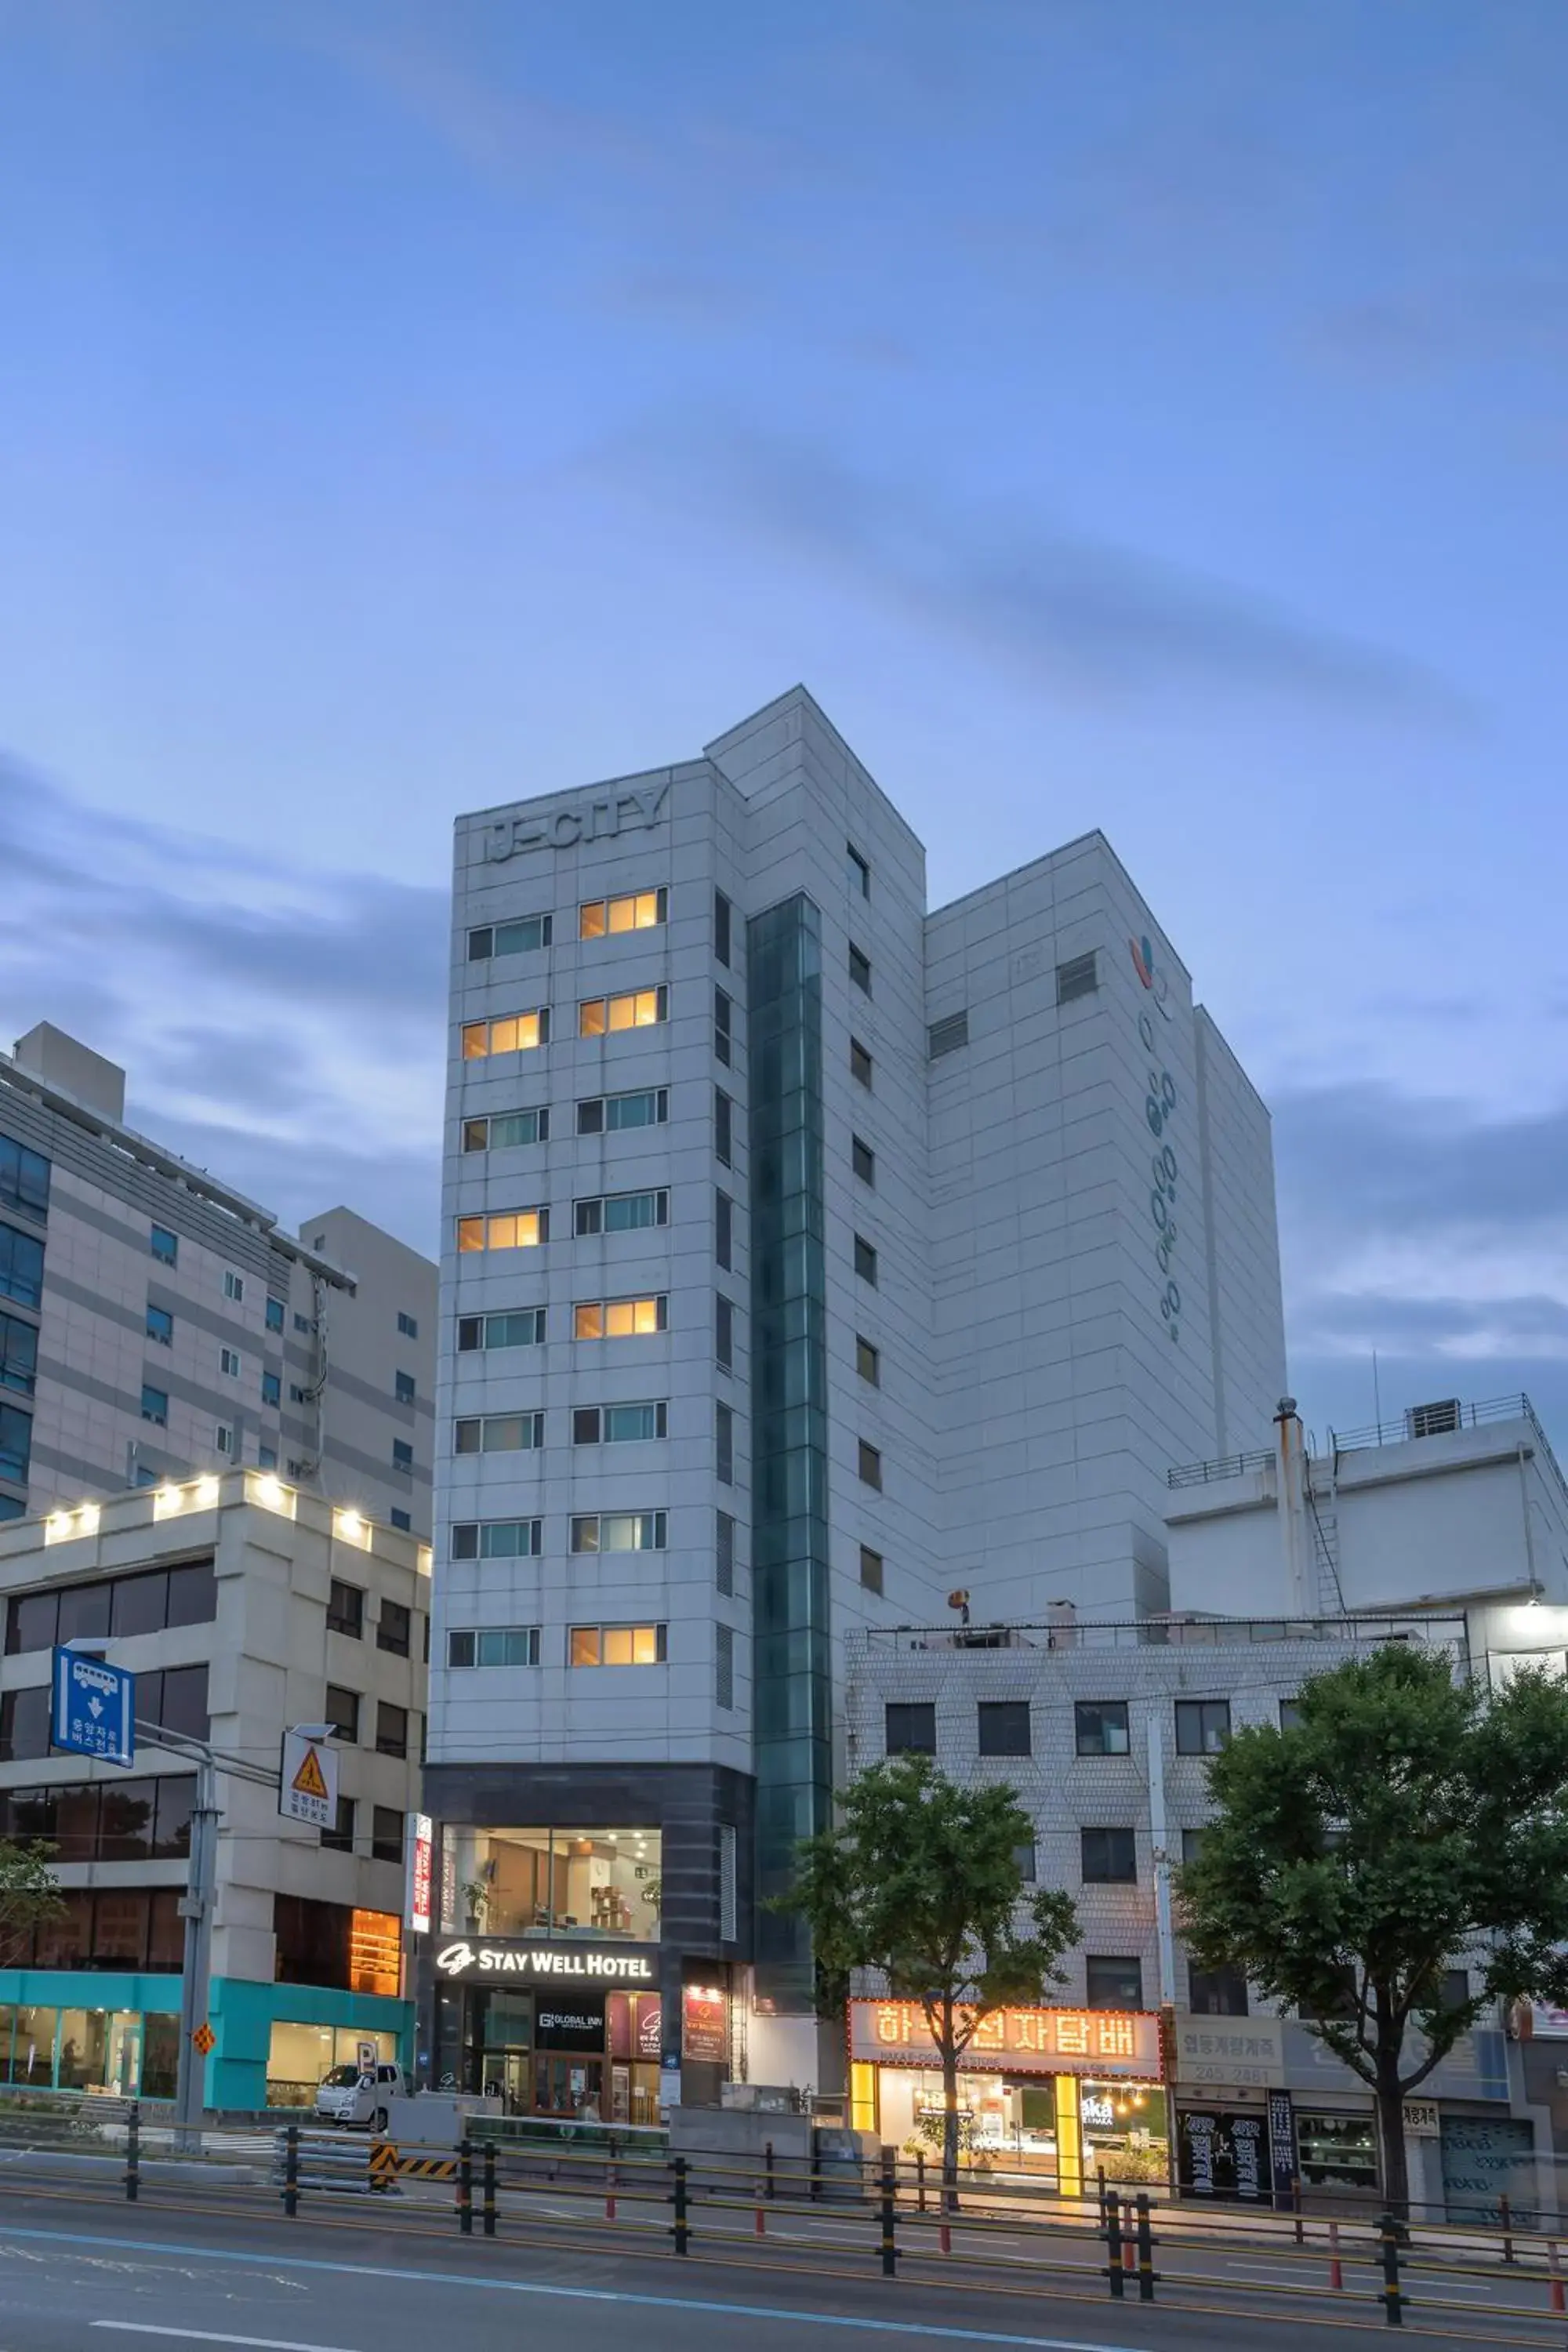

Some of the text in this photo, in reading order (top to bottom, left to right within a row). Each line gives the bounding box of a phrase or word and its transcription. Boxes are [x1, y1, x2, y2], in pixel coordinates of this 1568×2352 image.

[478, 1949, 652, 1977] STAY WELL HOTEL
